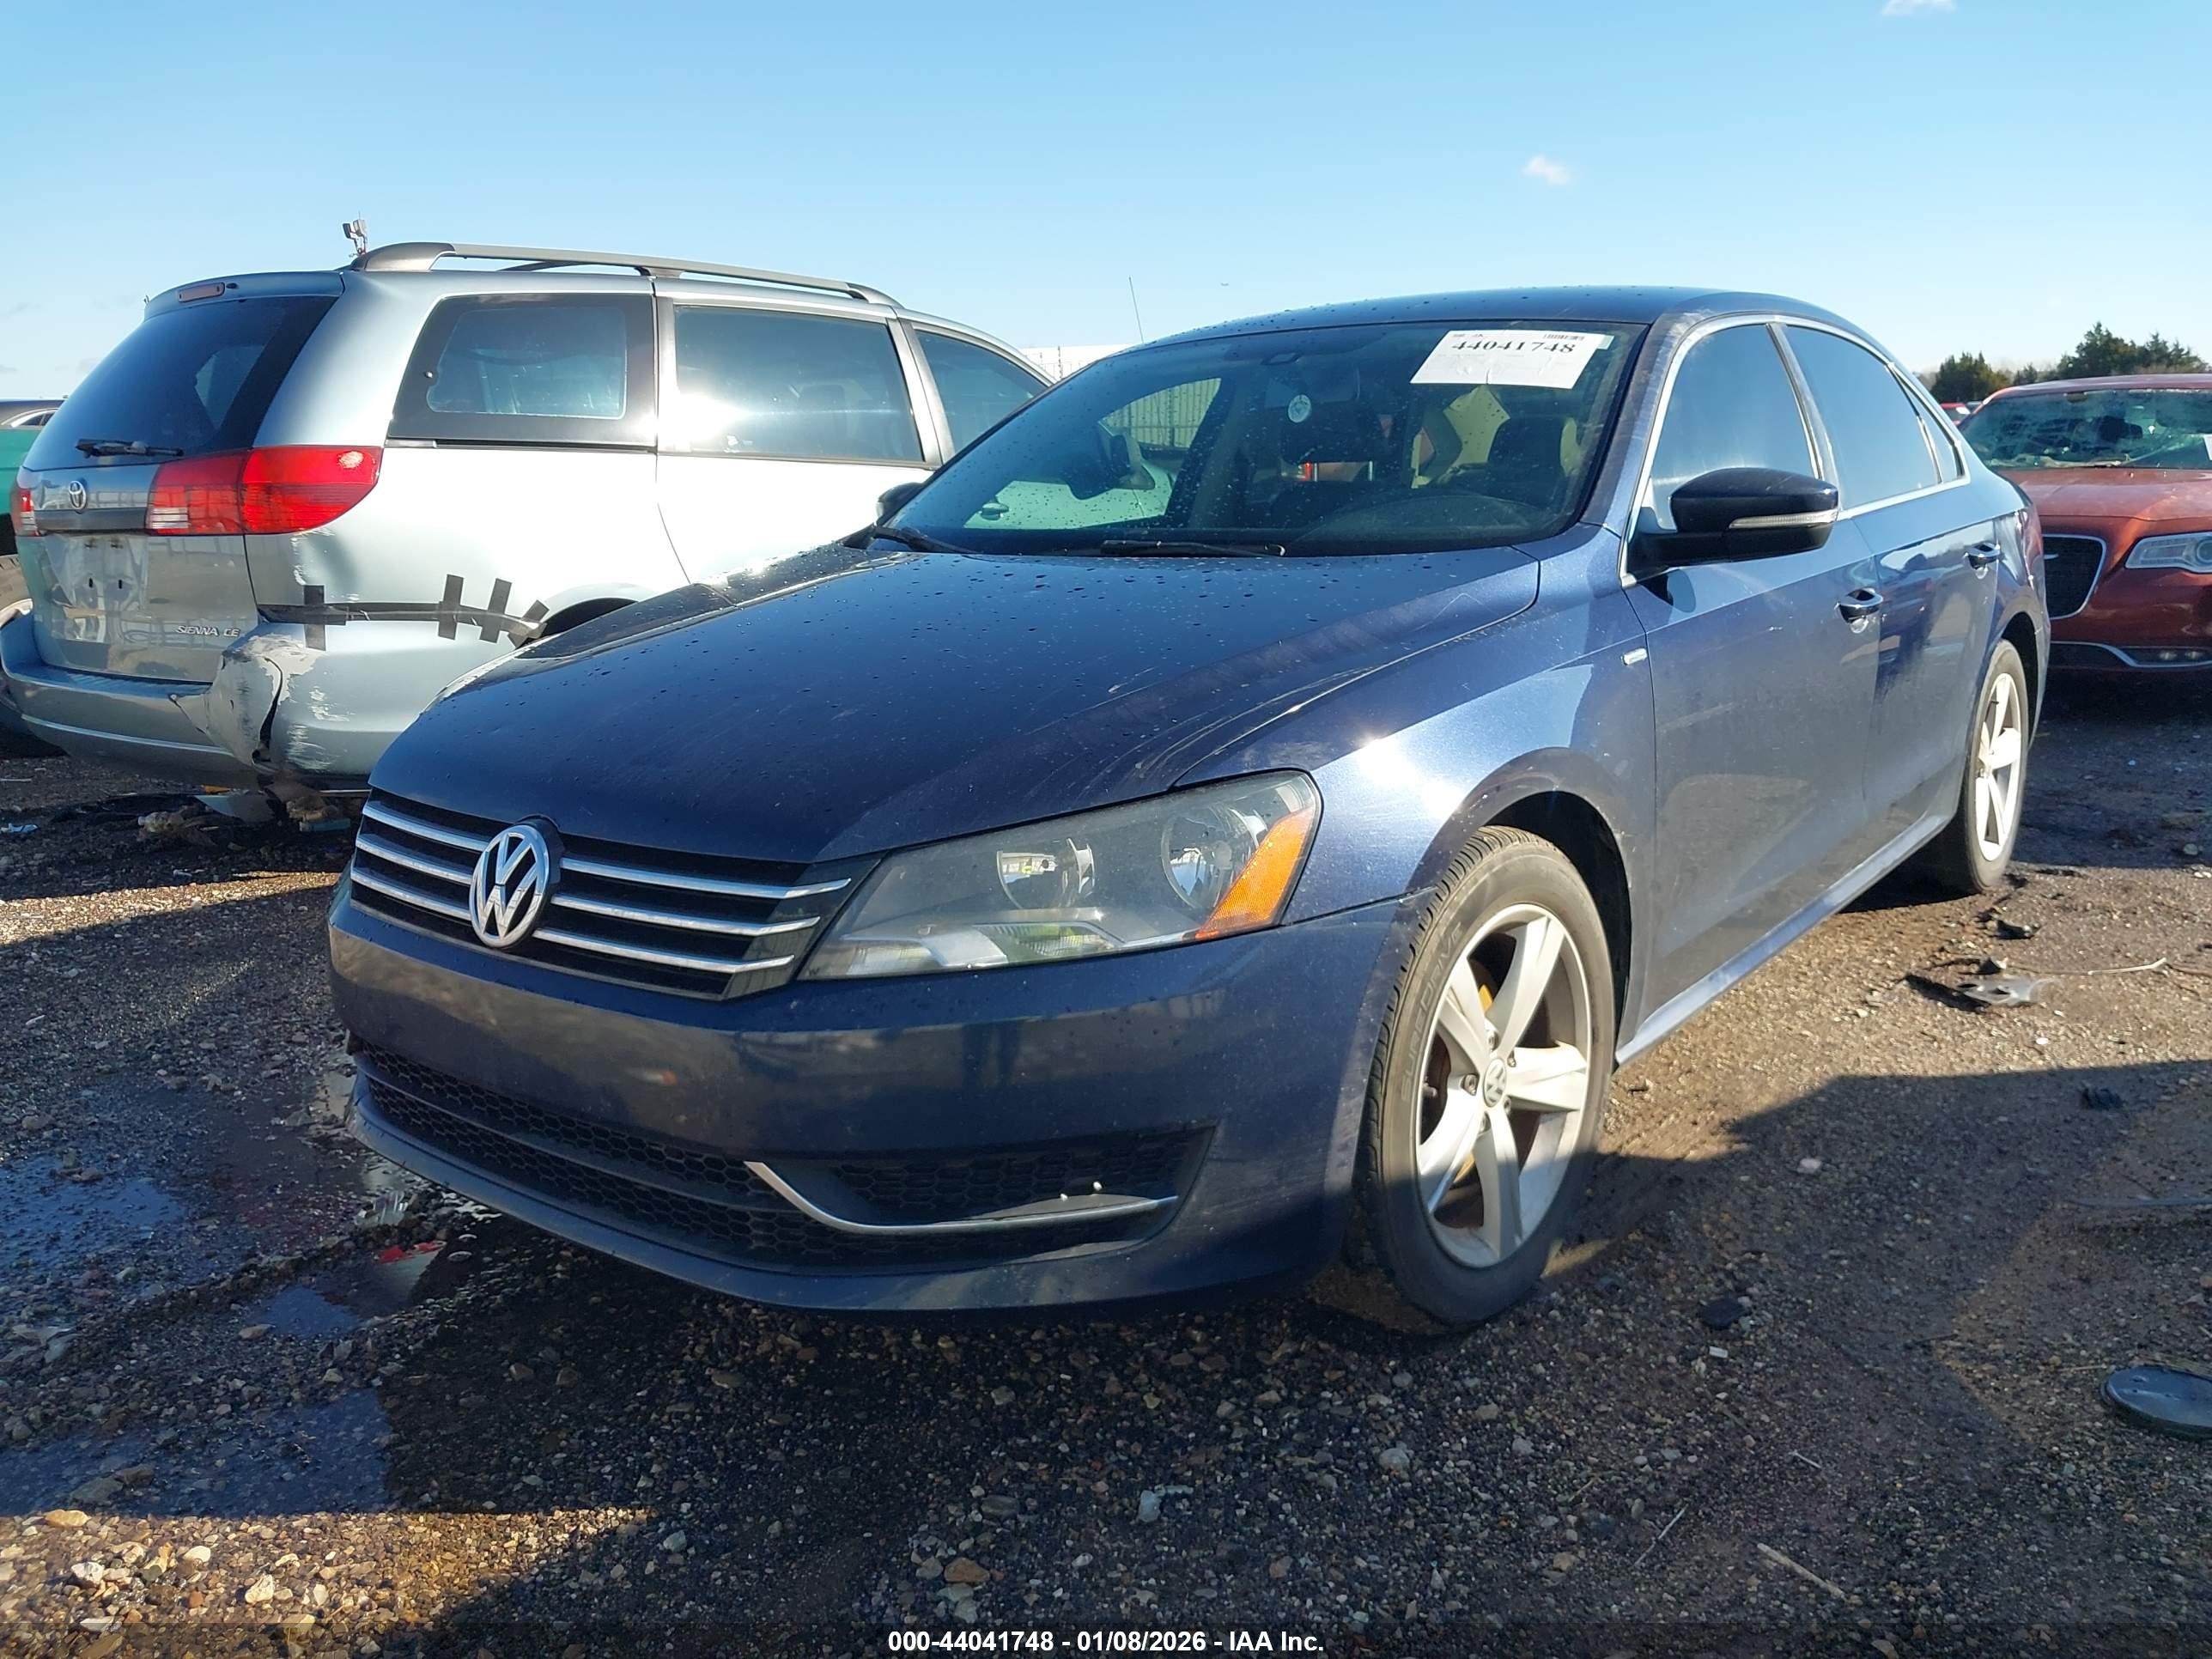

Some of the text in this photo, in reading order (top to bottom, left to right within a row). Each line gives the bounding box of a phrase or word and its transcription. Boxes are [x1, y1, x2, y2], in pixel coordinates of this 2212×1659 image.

[1451, 340, 1577, 354] 44041748
[176, 625, 241, 637] SIENNA CE
